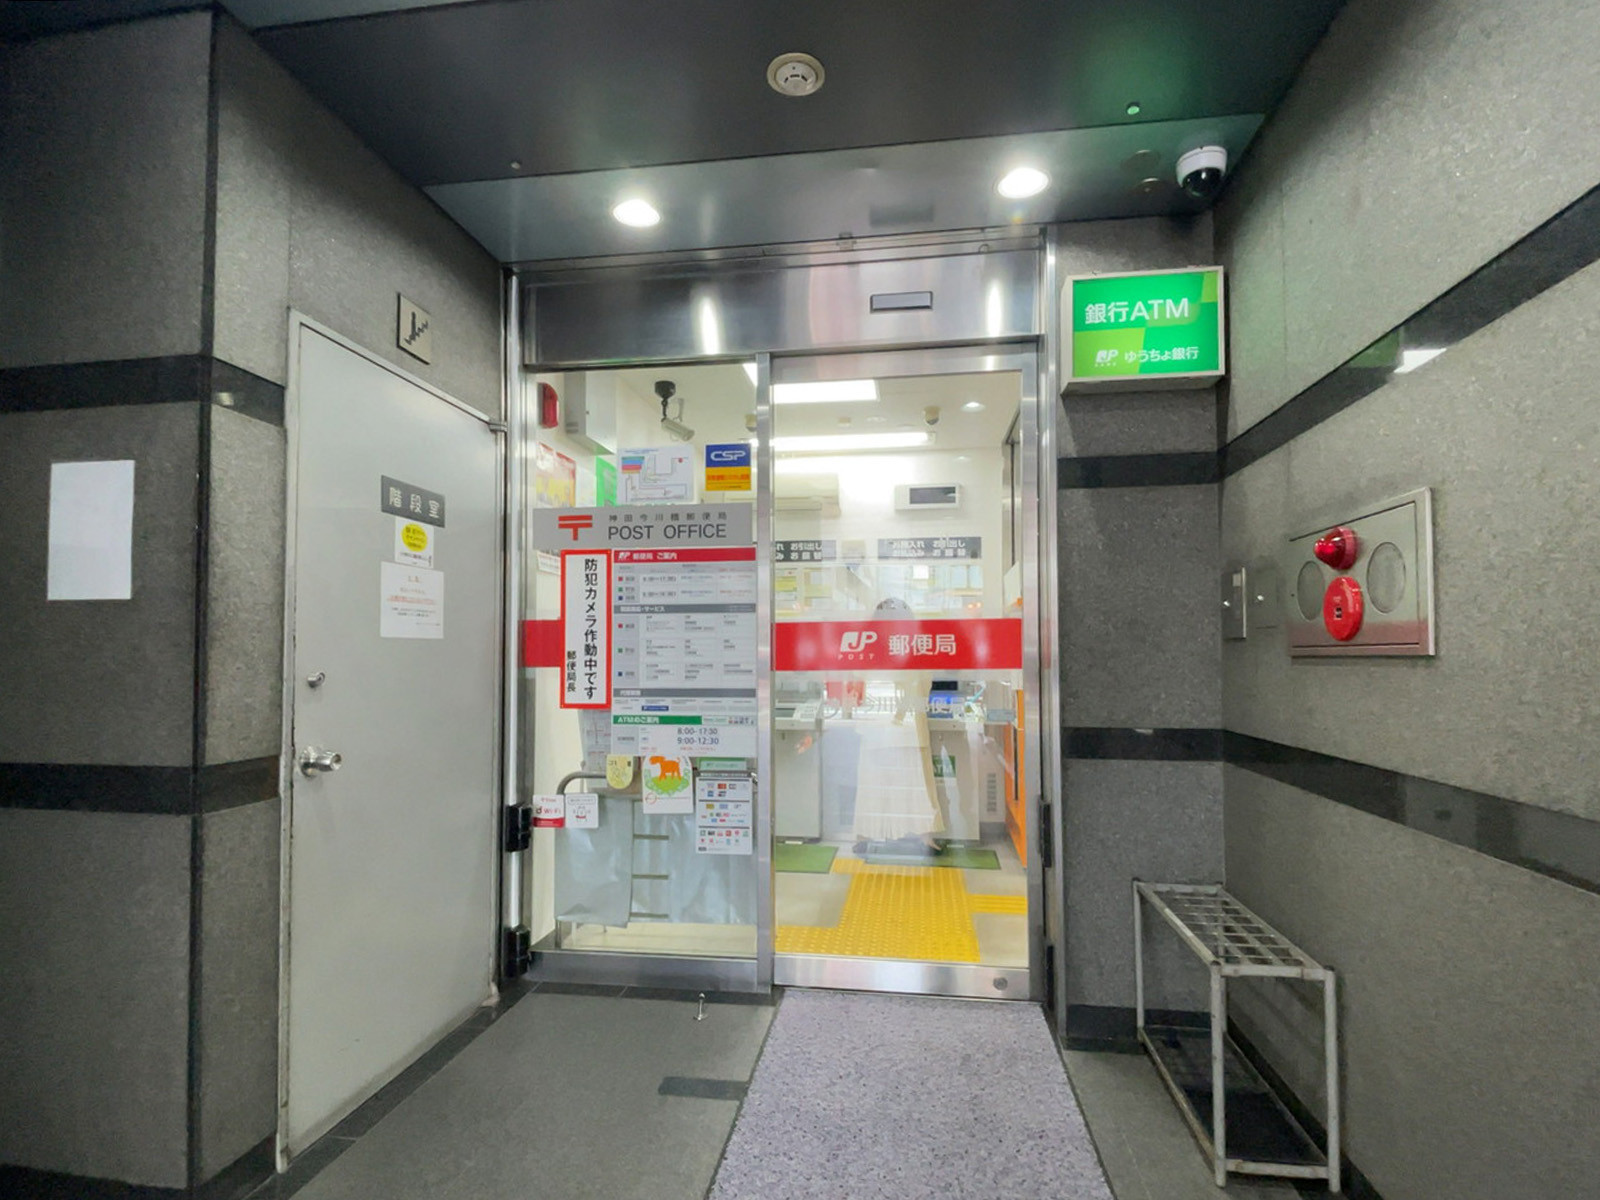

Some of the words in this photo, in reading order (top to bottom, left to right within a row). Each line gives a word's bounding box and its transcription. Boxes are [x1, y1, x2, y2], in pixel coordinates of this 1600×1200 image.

[1085, 298, 1189, 324] 銀行ATM
[1124, 346, 1199, 363] ゆうちょ銀行
[710, 450, 746, 462] CSP
[607, 525, 654, 541] POST
[663, 523, 727, 540] OFFICE
[584, 558, 599, 700] 防犯カメラ作動中です
[888, 634, 957, 656] 郵便局
[566, 650, 577, 693] 郵便局長
